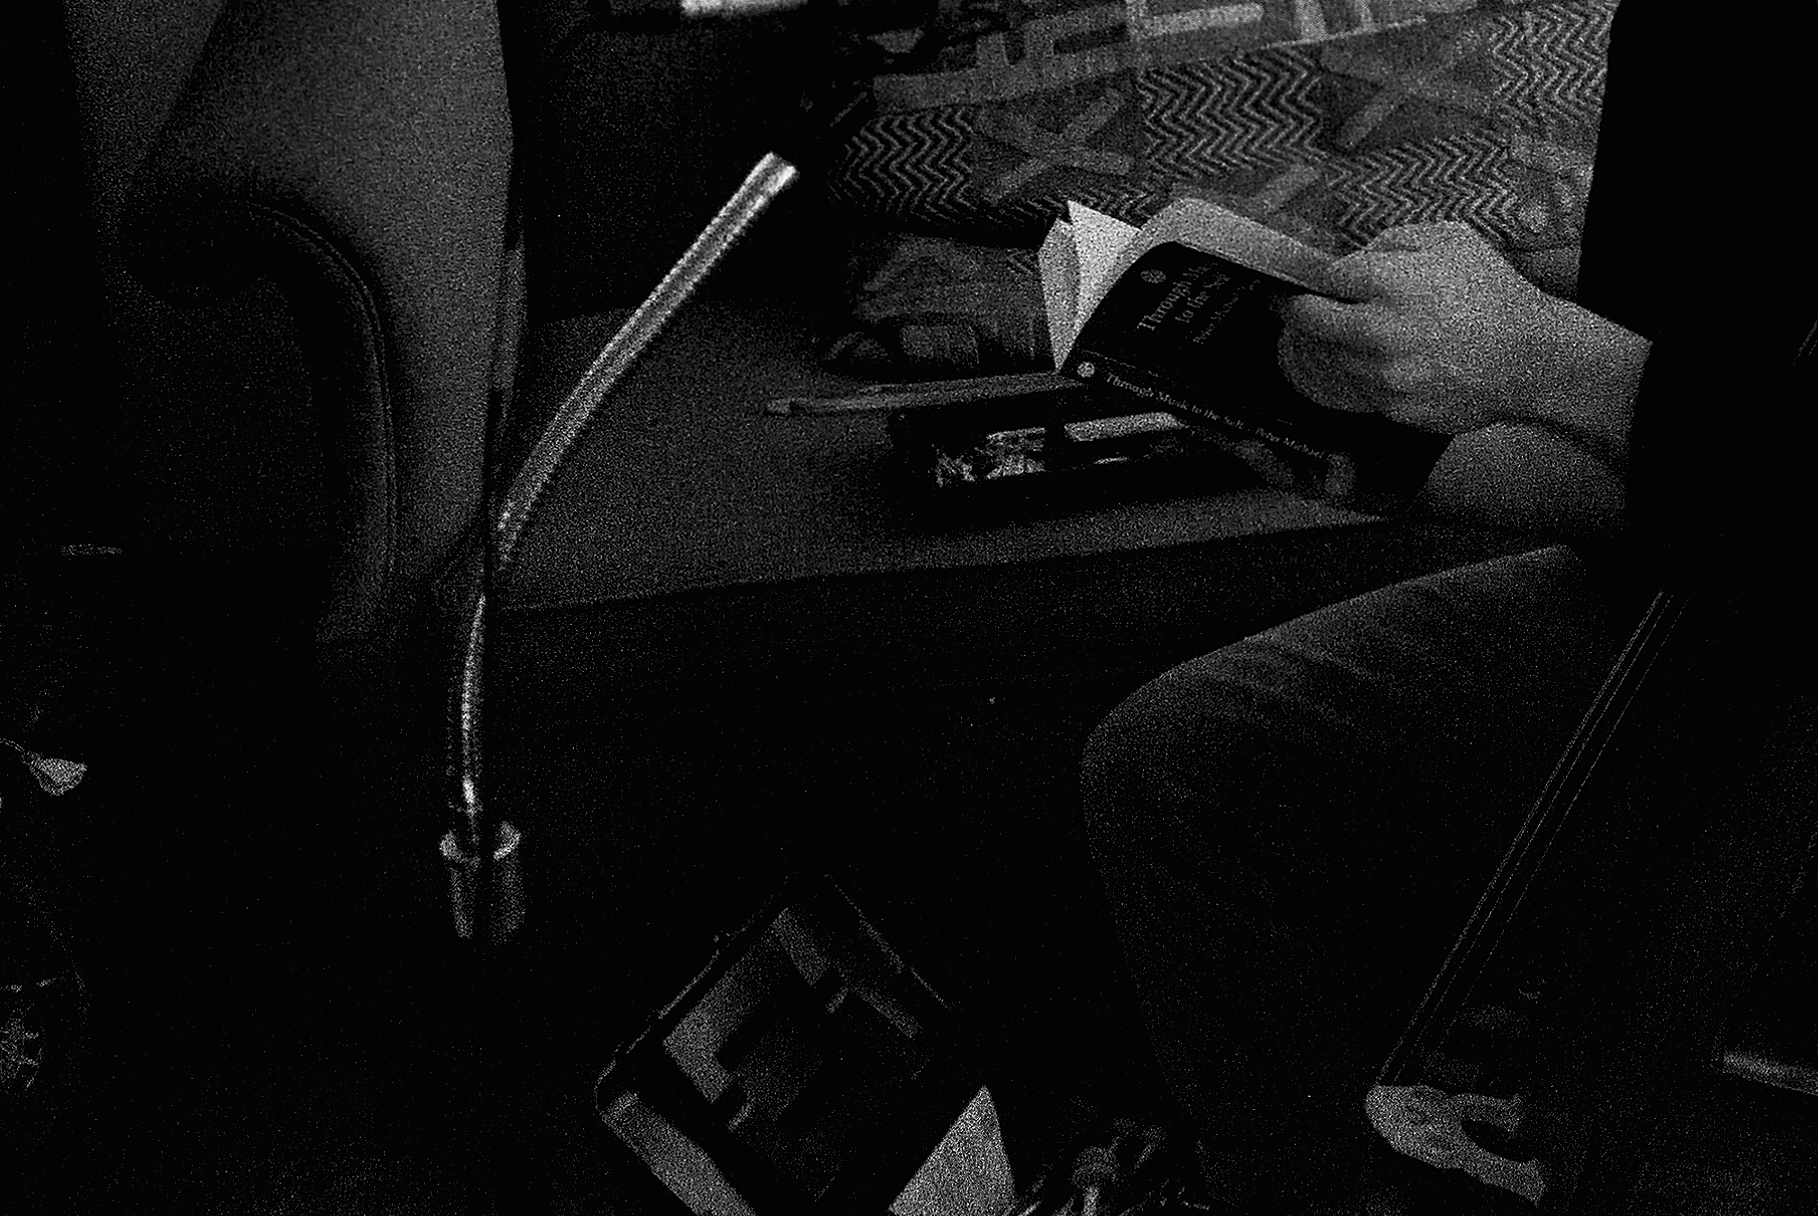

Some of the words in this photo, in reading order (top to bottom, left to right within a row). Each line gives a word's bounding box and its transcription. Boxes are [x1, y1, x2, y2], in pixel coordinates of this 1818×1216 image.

[1135, 279, 1193, 332] Through
[1174, 308, 1195, 325] to
[1186, 290, 1211, 309] the
[1105, 371, 1154, 398] Through
[1190, 403, 1202, 415] to
[1203, 408, 1221, 421] the
